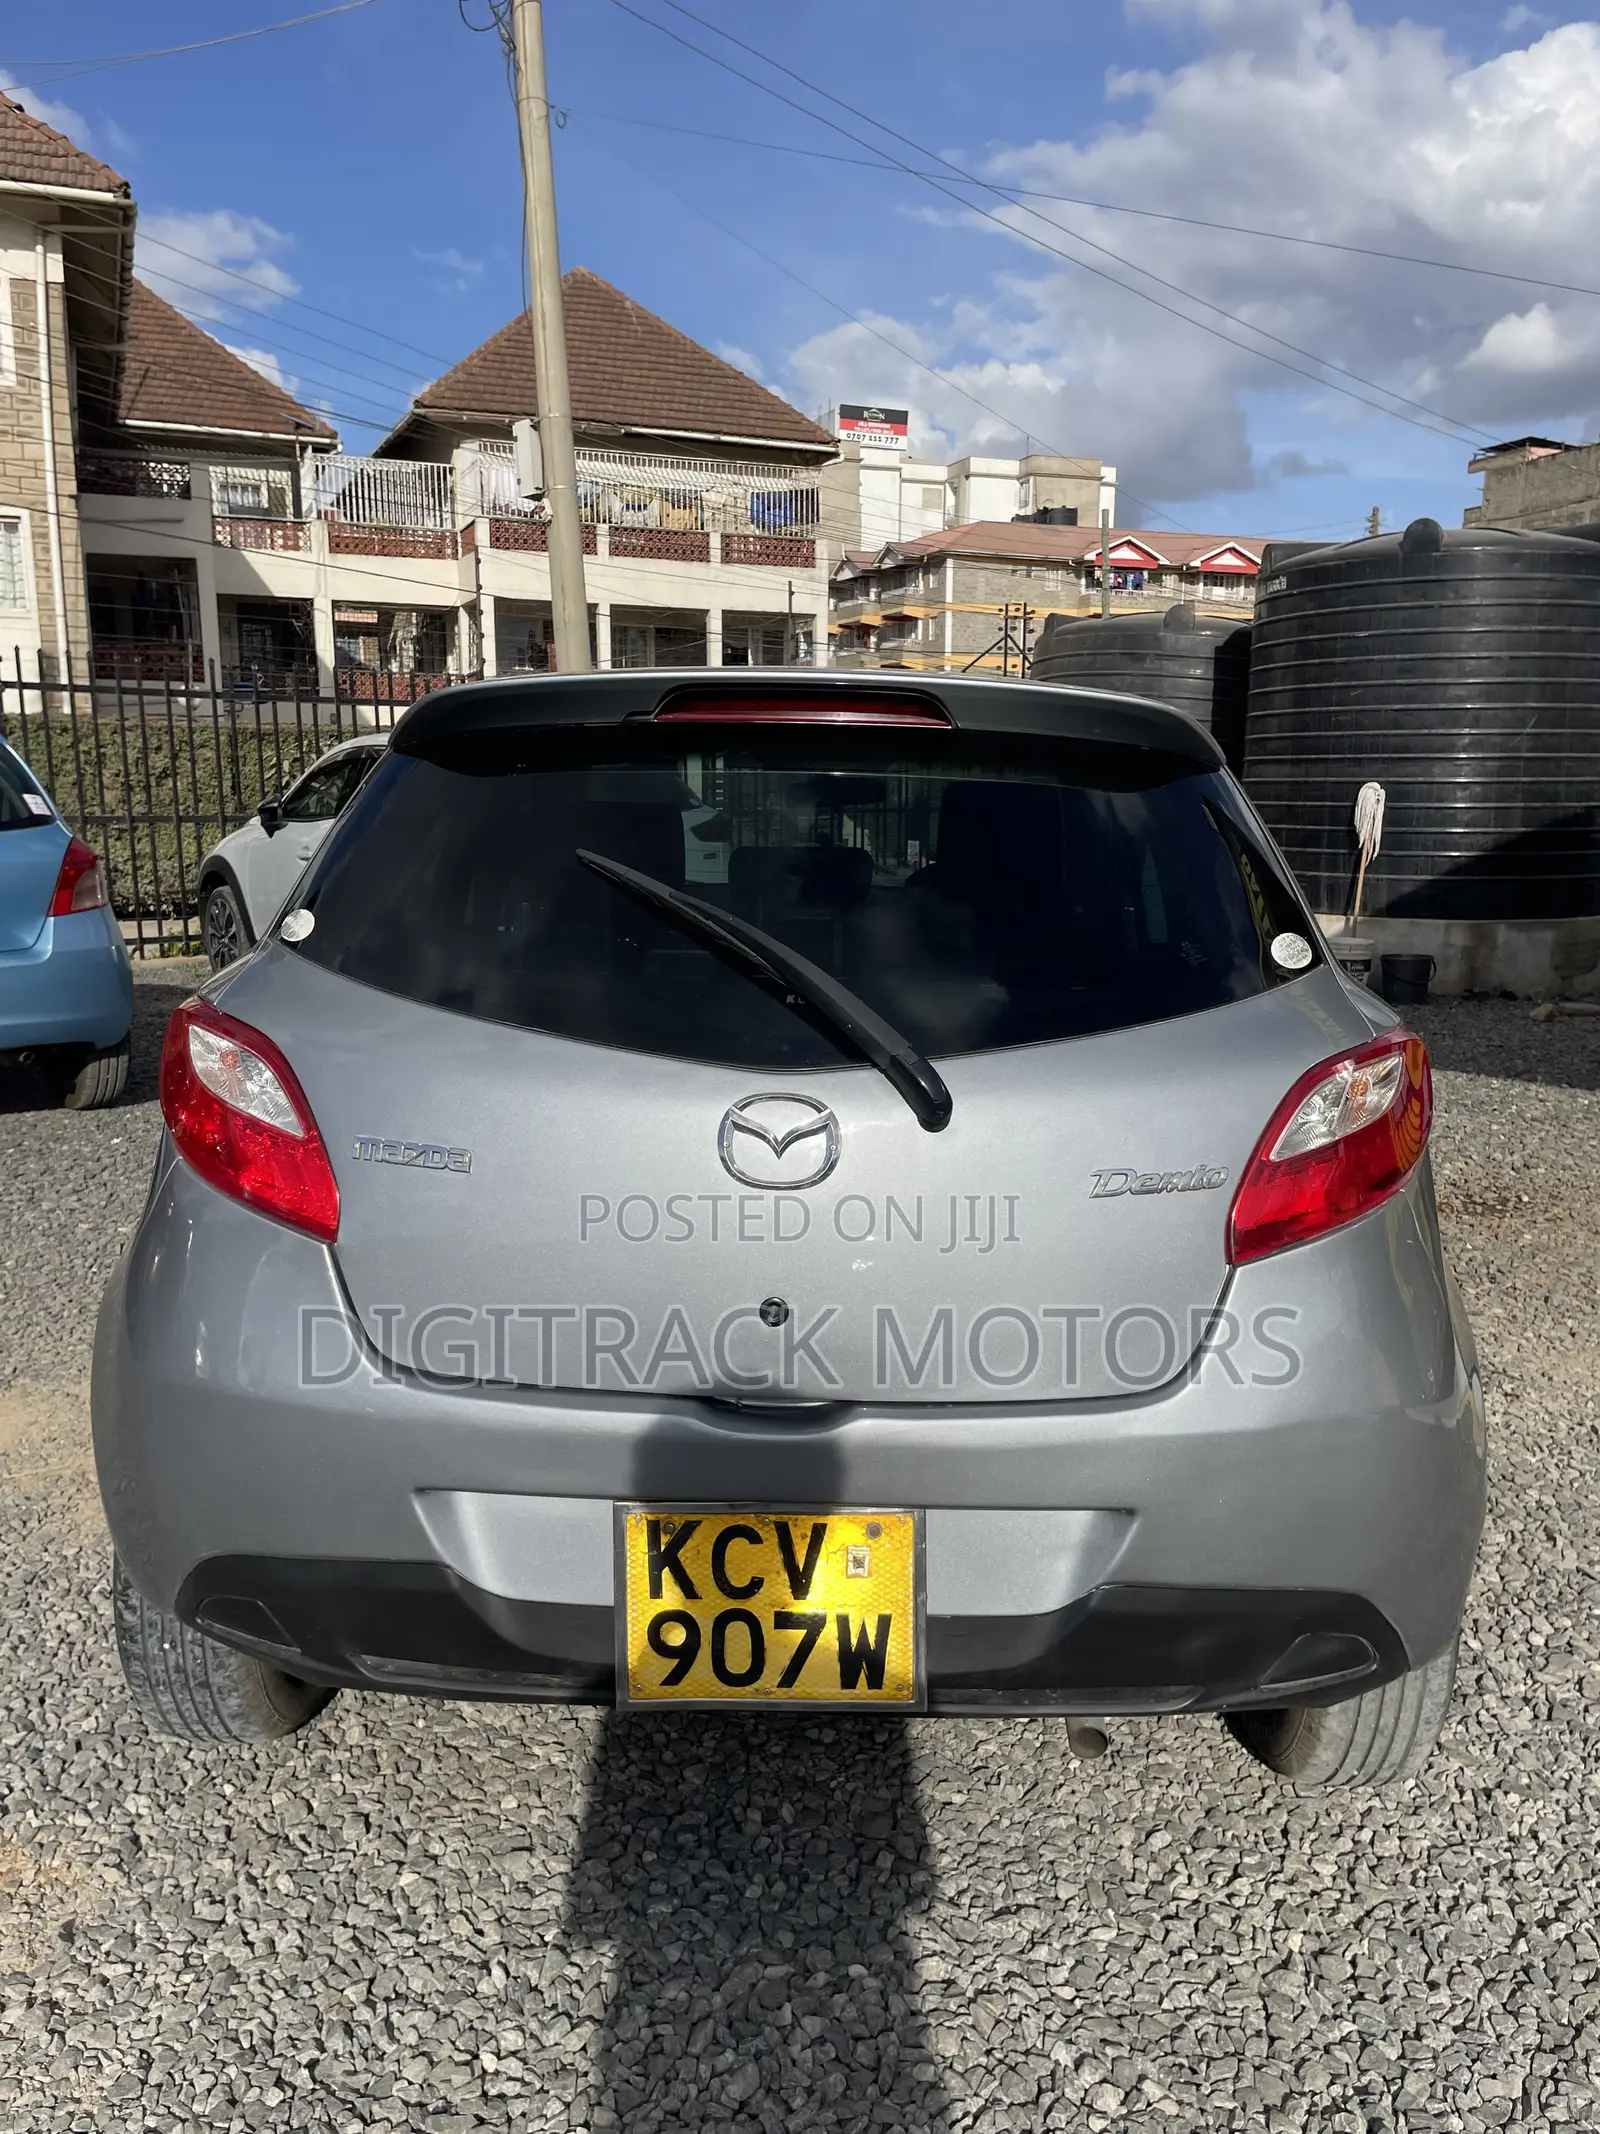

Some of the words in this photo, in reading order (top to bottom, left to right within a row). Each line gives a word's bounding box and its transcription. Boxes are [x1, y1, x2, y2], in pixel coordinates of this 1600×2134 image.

[846, 432, 866, 441] 0707
[884, 436, 899, 445] 777
[352, 1134, 473, 1174] mazda
[1088, 1164, 1230, 1199] Demio
[647, 1520, 827, 1601] KCV
[647, 1608, 892, 1690] 907W
